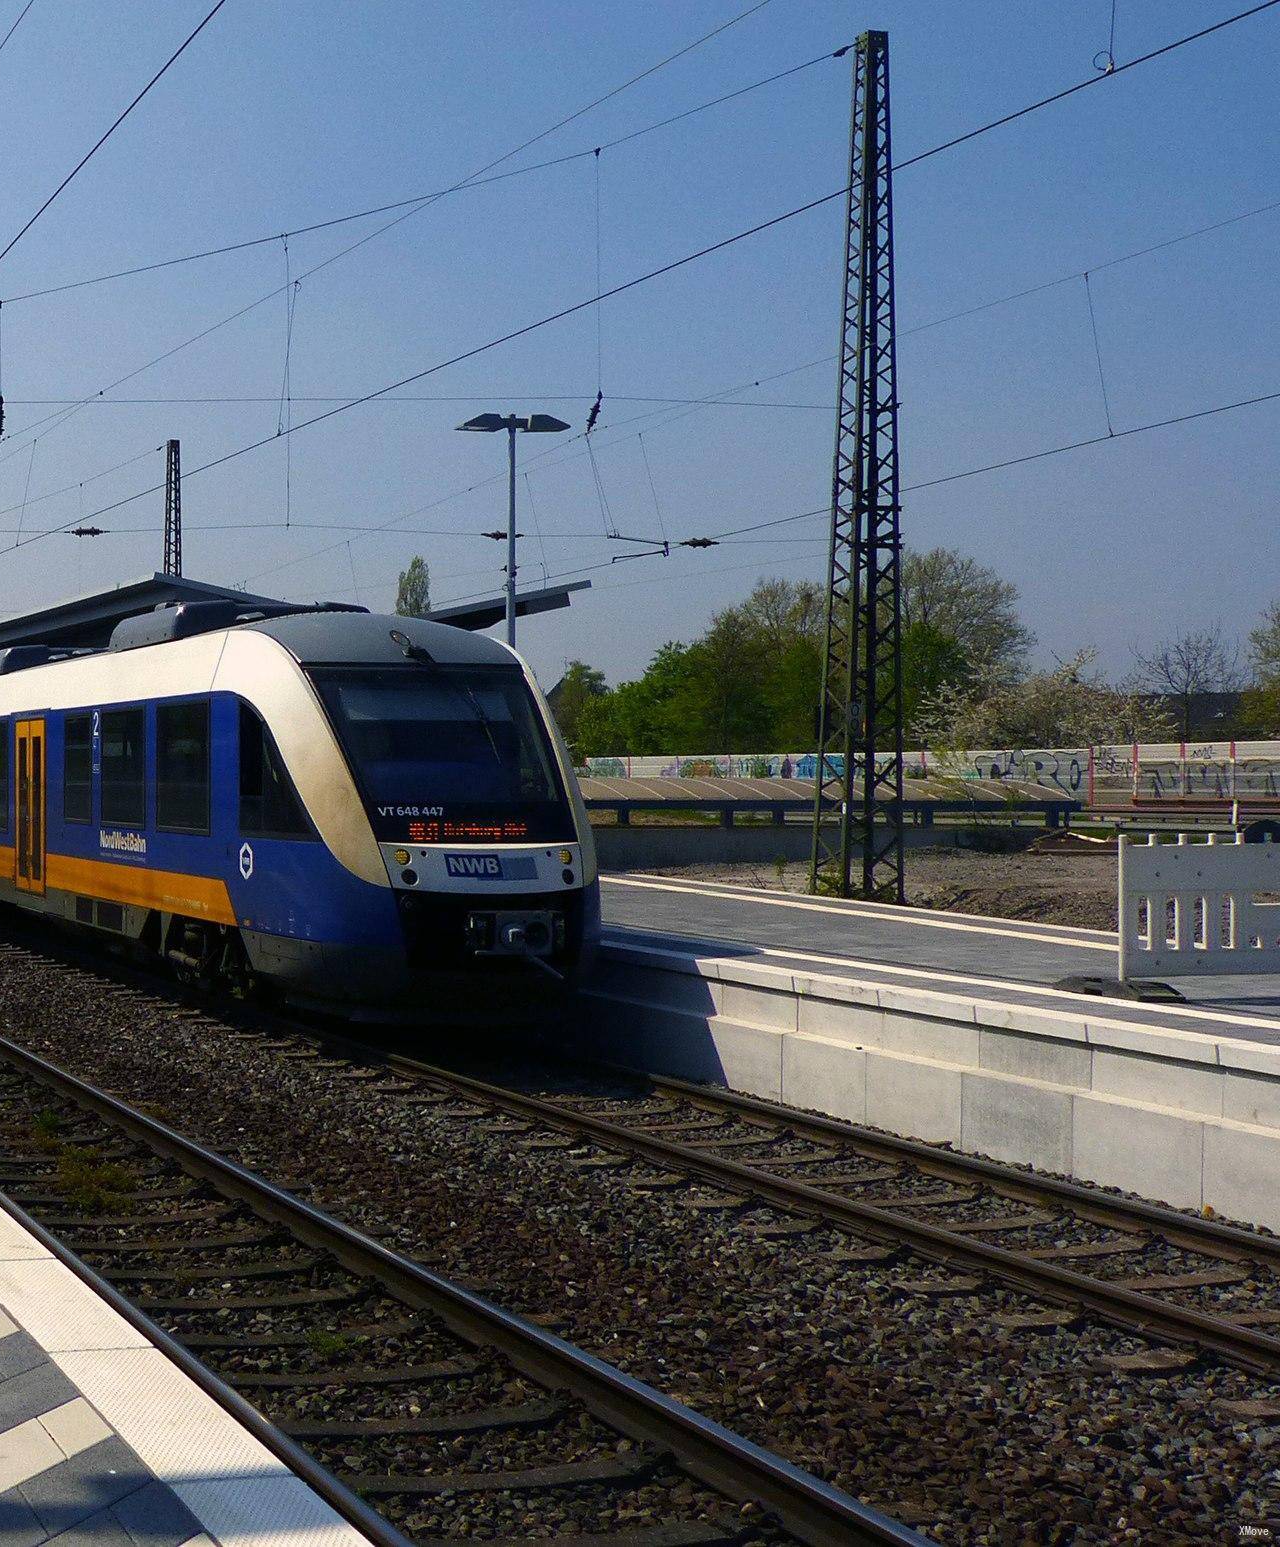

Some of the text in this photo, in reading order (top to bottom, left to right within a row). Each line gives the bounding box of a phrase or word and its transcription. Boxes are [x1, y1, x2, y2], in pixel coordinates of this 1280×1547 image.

[93, 712, 99, 736] 2
[377, 806, 444, 817] VT 648 447
[99, 830, 147, 853] NordWestBahn
[448, 857, 500, 875] NWB
